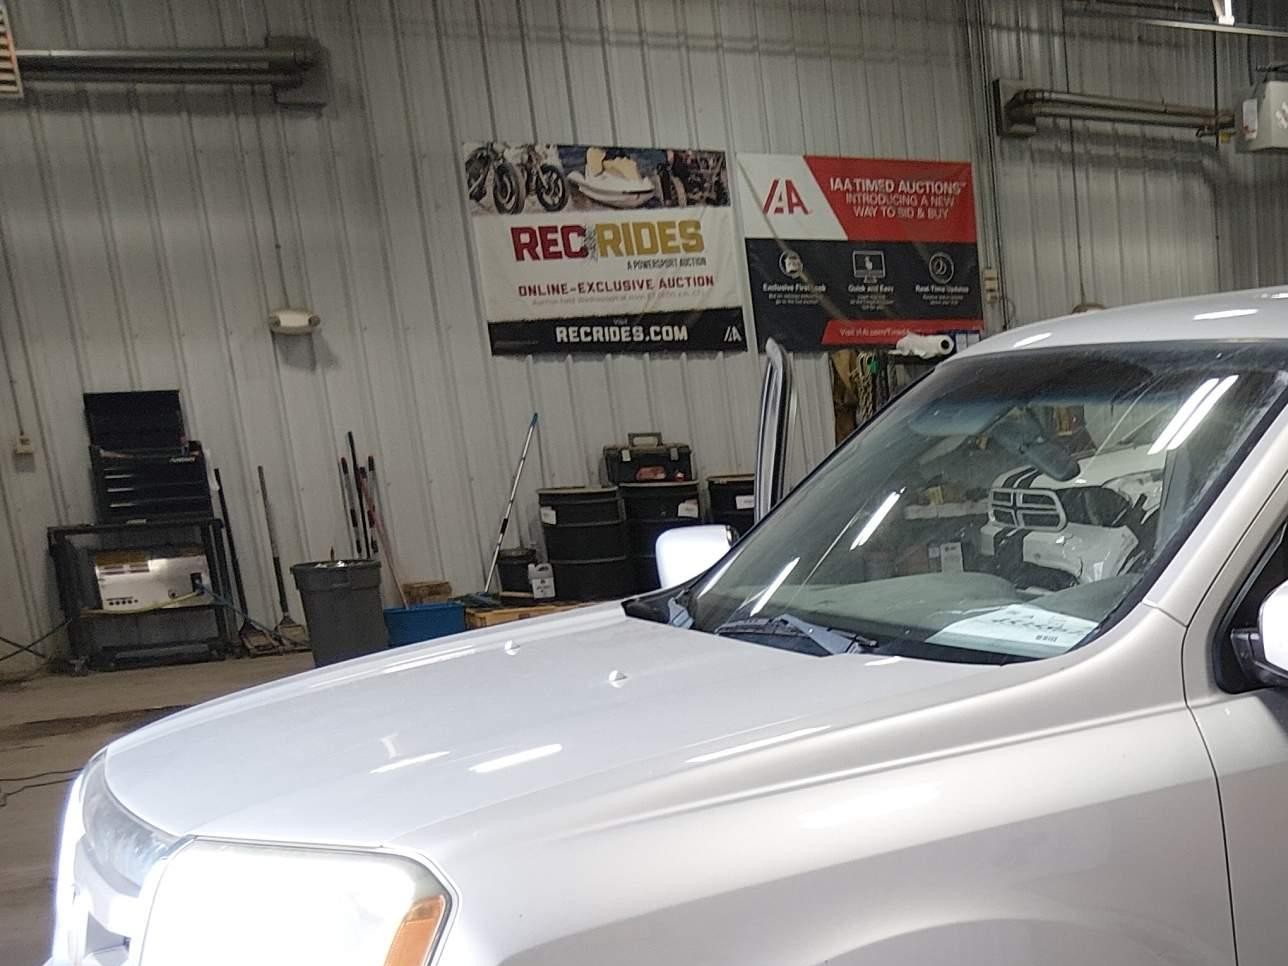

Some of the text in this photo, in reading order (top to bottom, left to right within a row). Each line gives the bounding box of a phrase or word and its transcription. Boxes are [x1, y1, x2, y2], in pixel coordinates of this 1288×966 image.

[830, 177, 852, 192] IAA
[854, 178, 895, 193] TIMED
[846, 193, 956, 207] INTRODUCING A NEW
[853, 205, 949, 219] WAY TO BID & BUY
[510, 219, 705, 262] REC RIDES
[679, 256, 707, 267] AUCTION
[518, 275, 715, 297] ONLINE-EXCLUSIVE AUCTION
[555, 325, 689, 343] RECRIDES.COM
